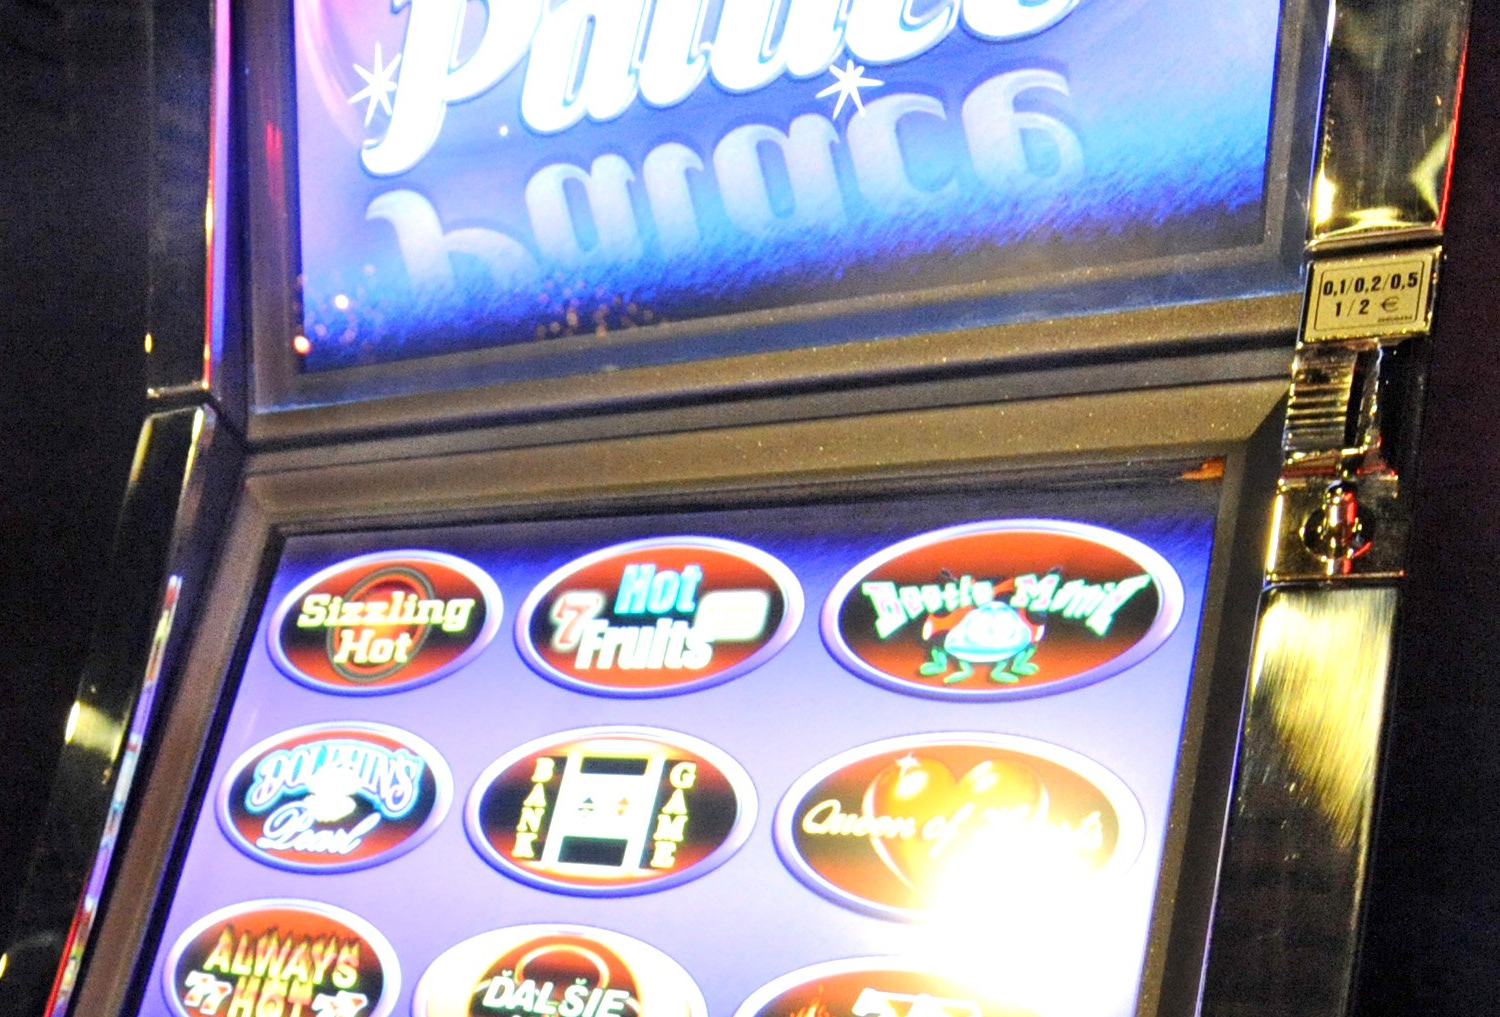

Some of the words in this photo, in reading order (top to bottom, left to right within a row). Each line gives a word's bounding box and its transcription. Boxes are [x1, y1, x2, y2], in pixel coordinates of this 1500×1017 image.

[297, 591, 475, 632] Sizzling
[614, 563, 704, 615] Hot
[334, 628, 409, 664] Hot
[573, 616, 714, 670] Fruits
[511, 757, 555, 858] BANK
[650, 761, 697, 868] GAME
[802, 799, 918, 840] Queen
[203, 926, 360, 989] ALWAYS
